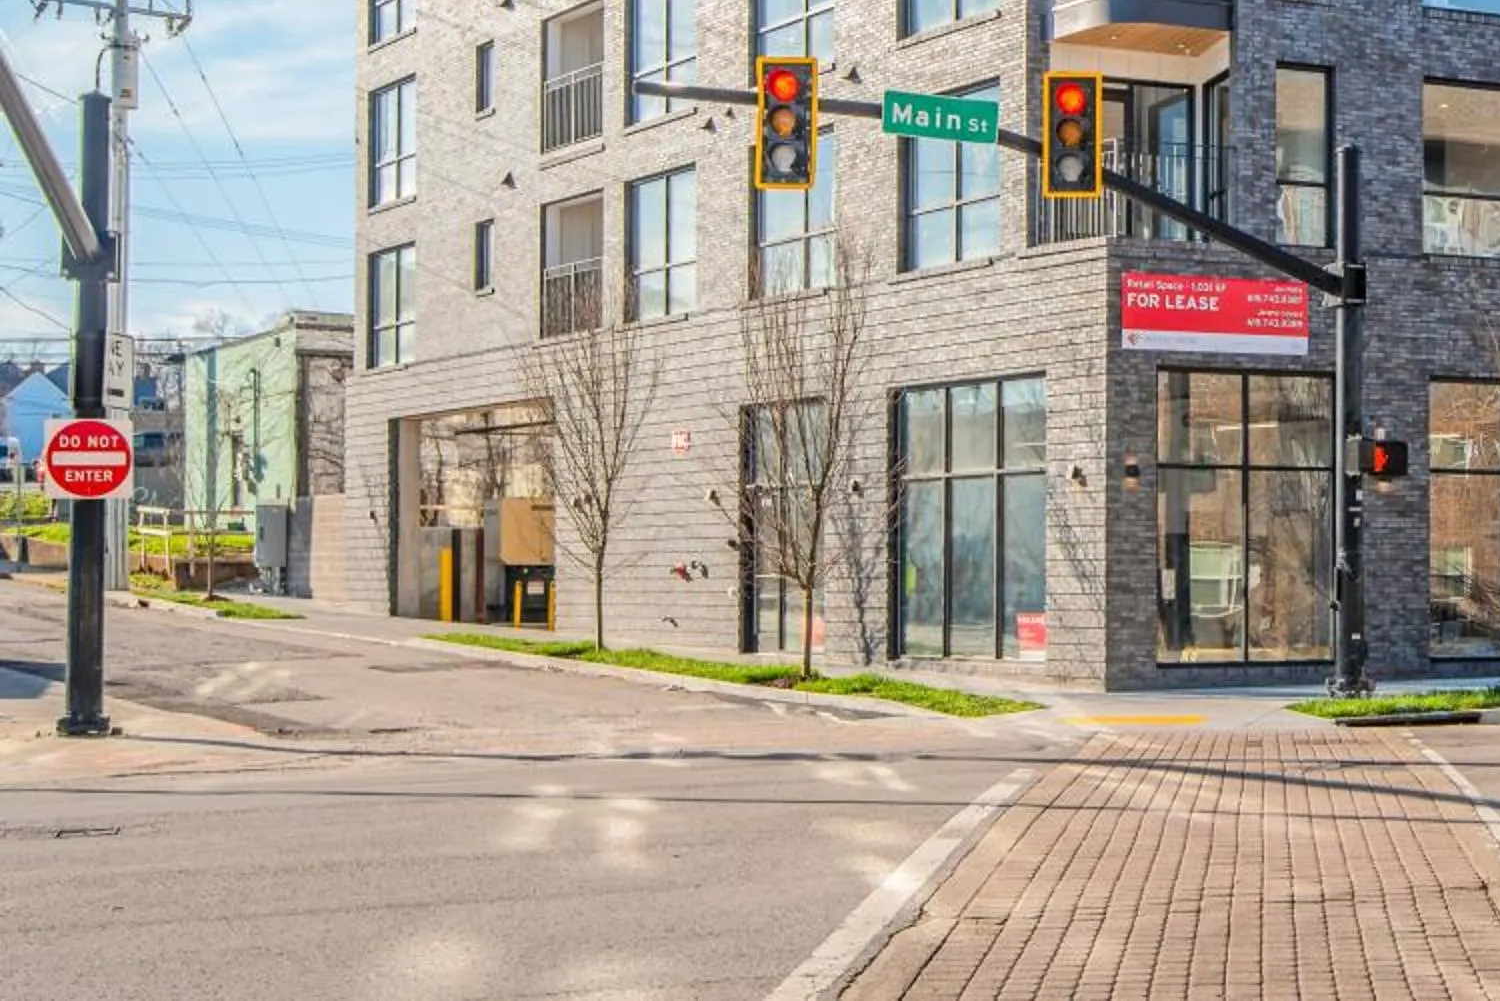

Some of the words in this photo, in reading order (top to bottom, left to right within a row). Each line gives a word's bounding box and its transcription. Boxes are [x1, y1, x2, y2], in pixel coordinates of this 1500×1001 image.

[891, 102, 961, 130] Main
[967, 117, 989, 132] St
[1127, 292, 1160, 309] FOR
[1165, 294, 1220, 312] LEASE
[59, 434, 81, 448] DO
[87, 434, 120, 449] NOT
[65, 469, 113, 483] ENTER
